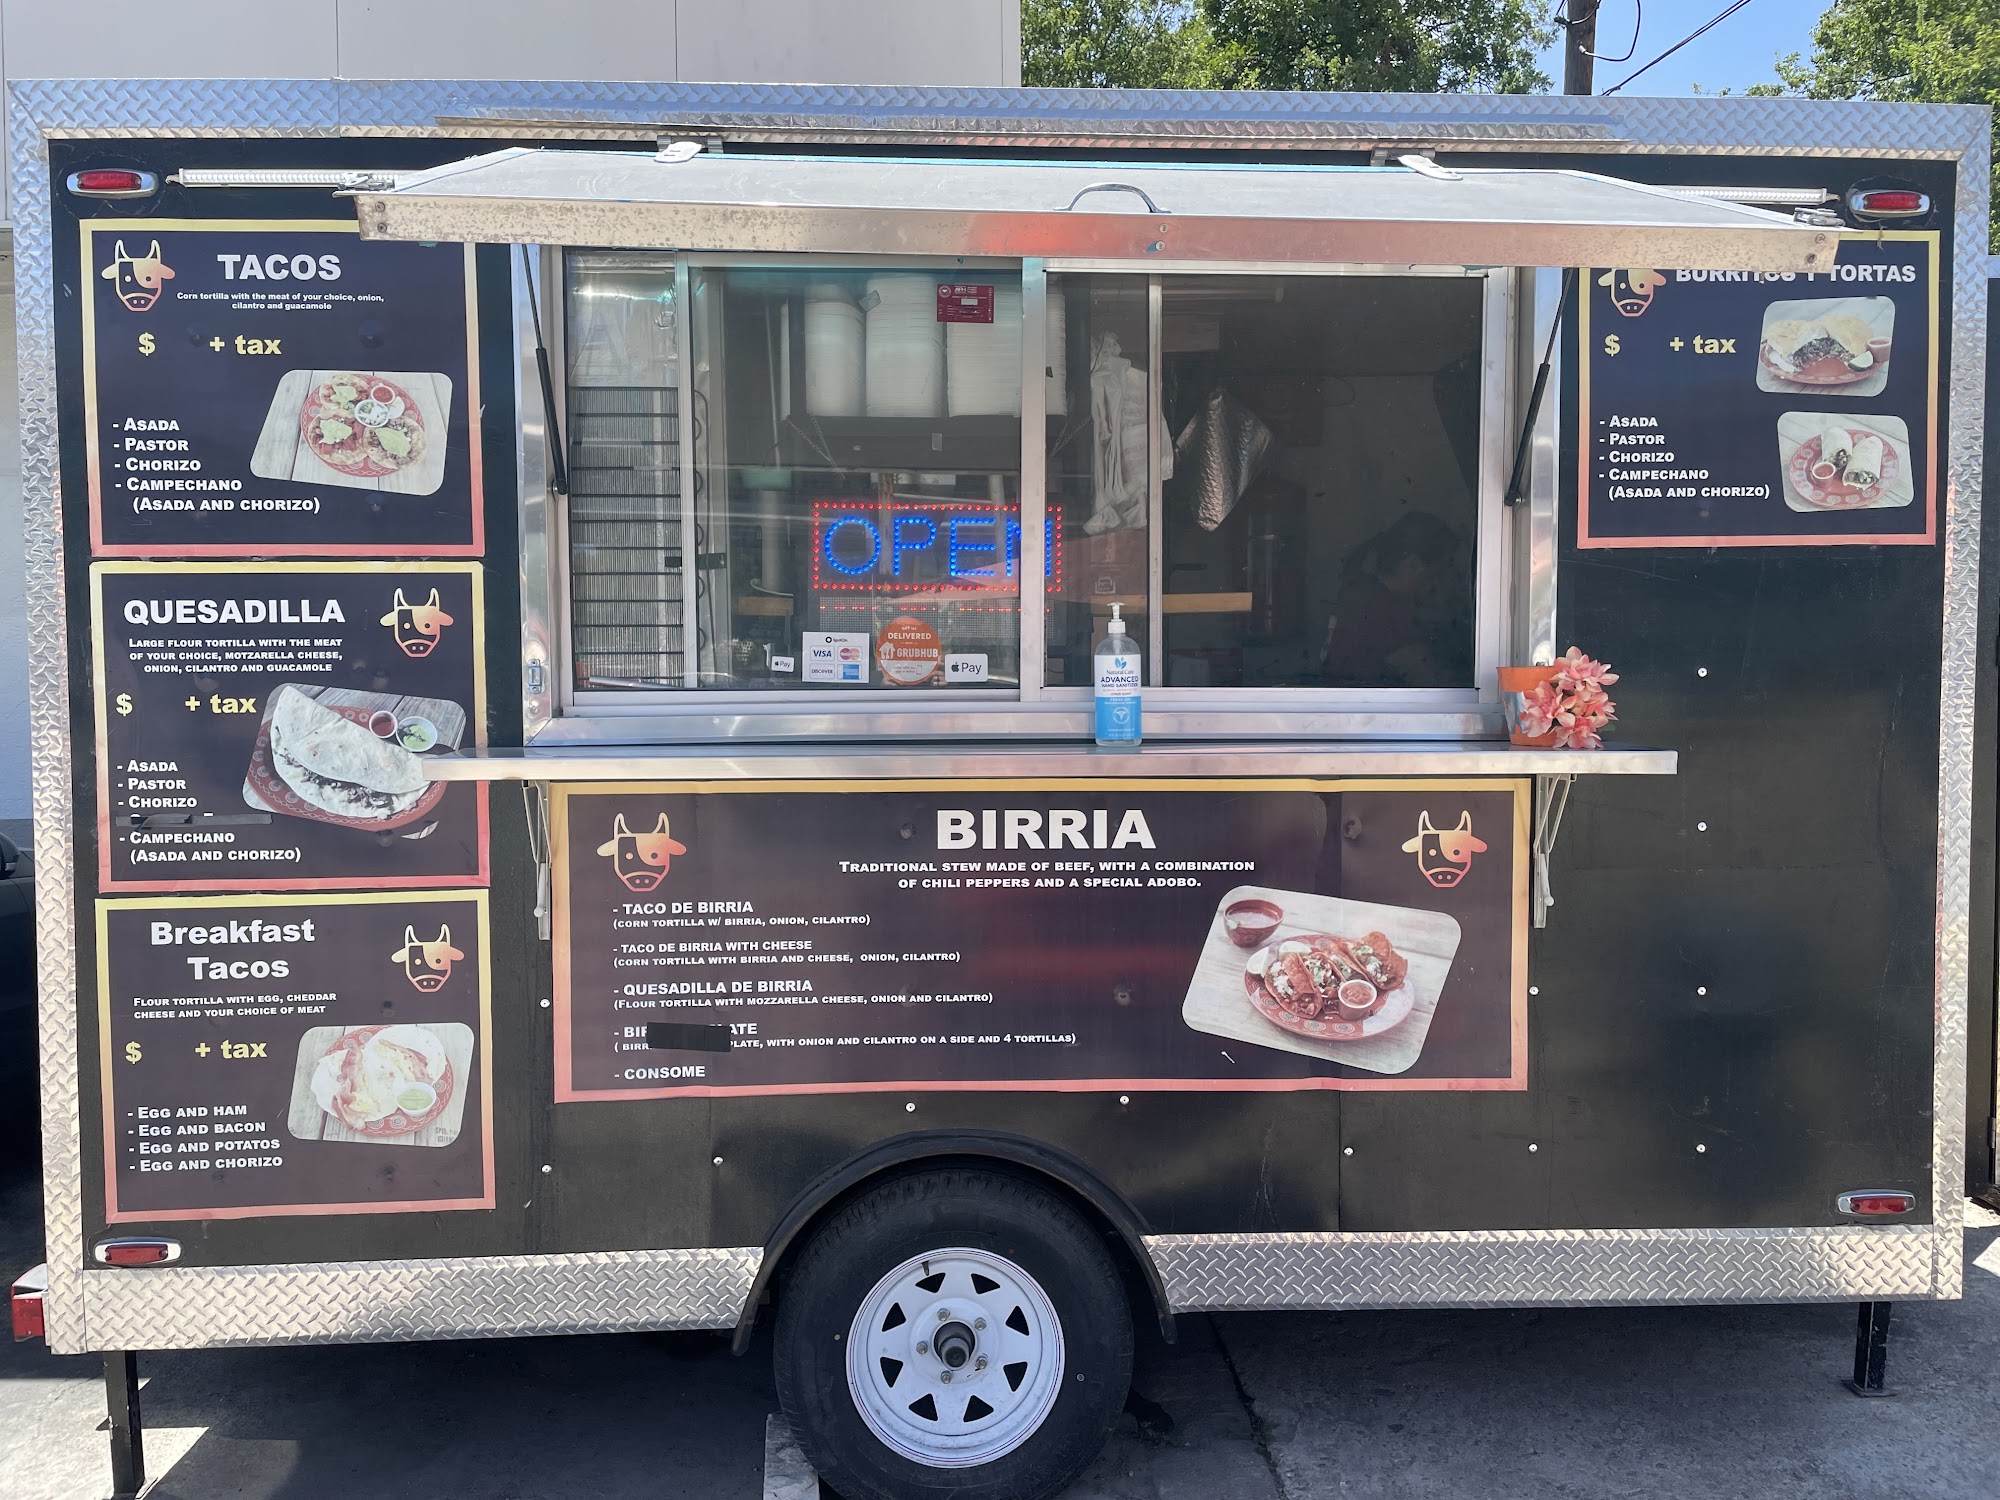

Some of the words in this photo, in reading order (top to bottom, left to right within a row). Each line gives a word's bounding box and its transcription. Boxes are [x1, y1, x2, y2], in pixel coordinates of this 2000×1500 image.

[217, 254, 341, 280] TACOS
[1828, 263, 1916, 282] TORTAS
[177, 292, 198, 300] Corn
[200, 292, 229, 300] tortilla
[231, 292, 250, 300] with
[252, 292, 266, 300] the
[292, 292, 301, 300] of
[302, 294, 322, 302] your
[324, 293, 356, 302] choice,
[357, 294, 384, 302] onion,
[285, 302, 332, 310] guacamole
[234, 334, 282, 354] tax
[1693, 334, 1736, 354] tax
[124, 418, 180, 431] ASADA
[1609, 415, 1658, 427] ASADA
[125, 438, 189, 451] PASTOR
[1610, 433, 1665, 445] PASTOR
[1609, 450, 1674, 463] CHORIZO
[126, 457, 201, 471] CHORIZO
[1609, 468, 1709, 480] CAMPECHANO
[127, 477, 242, 491] CAMPECHANO
[1609, 486, 1662, 501] (ASADA
[1666, 488, 1696, 497] AND
[1701, 484, 1770, 499] CHORIZO)
[133, 497, 195, 514] (ASADA
[200, 500, 234, 510] AND
[240, 497, 320, 514] CHORIZO)
[824, 515, 1052, 578] OPEN
[124, 599, 346, 626] QUESADILLA
[888, 632, 932, 640] DELIVERED
[129, 638, 164, 648] LARGE
[205, 639, 256, 647] TORTILLA
[130, 652, 144, 660] OF
[146, 652, 176, 660] YOUR
[179, 652, 222, 662] CHOICE,
[225, 652, 294, 660] MOTZARELLA
[297, 651, 342, 660] CHEESE,
[813, 649, 832, 658] VISA
[896, 648, 939, 658] GRUBHUB
[144, 665, 182, 674] ONION,
[185, 664, 238, 672] CILANTRO
[241, 664, 263, 672] AND
[266, 664, 332, 672] GUACAMOLE
[961, 662, 982, 674] Pay
[210, 694, 257, 713] tax
[127, 760, 178, 772] ASADA
[128, 778, 186, 790] PASTOR
[128, 796, 197, 808] CHORIZO
[937, 810, 1156, 850] BIRRIA
[130, 832, 235, 844] CAMPECHANO
[130, 849, 187, 865] (ASADA
[191, 851, 223, 861] AND
[228, 847, 301, 862] CHORIZO)
[839, 861, 937, 872] TRADITIONAL
[942, 862, 982, 872] STEW
[986, 862, 1026, 871] MADE
[1031, 862, 1050, 871] OF
[1055, 862, 1094, 873] BEEF,
[1099, 862, 1136, 870] WITH
[1140, 862, 1150, 870] A
[1155, 862, 1254, 870] COMBINATION
[898, 879, 917, 888] OF
[922, 879, 960, 888] CHILI
[966, 878, 1030, 888] PEPPERS
[1034, 878, 1064, 887] AND
[1069, 878, 1079, 887] A
[1083, 878, 1143, 887] SPECIAL
[1147, 878, 1201, 887] ADOBO.
[622, 903, 666, 914] TACO
[672, 902, 693, 914] DE
[698, 901, 754, 913] BIRRIA
[613, 919, 648, 930] (CORN
[652, 919, 705, 927] TORTILLA
[708, 916, 721, 926] W/
[724, 918, 766, 927] BIRRIA,
[769, 917, 808, 926] ONION,
[812, 914, 870, 926] CILANTRO)
[151, 918, 315, 945] Breakfast
[620, 944, 655, 953] TACO
[658, 943, 676, 952] DE
[679, 942, 722, 952] BIRRIA
[726, 942, 758, 951] WITH
[762, 940, 812, 950] CHEESE
[614, 957, 648, 968] (CORN
[652, 957, 705, 966] TORTILLA
[708, 956, 736, 964] WITH
[740, 956, 778, 964] BIRRIA
[780, 955, 804, 963] AND
[808, 954, 853, 963] CHEESE,
[860, 954, 899, 963] ONION,
[902, 951, 960, 962] CILANTRO)
[187, 957, 289, 980] Tacos
[624, 982, 727, 996] QUESADILLA
[732, 981, 752, 992] DE
[758, 980, 813, 992] BIRRIA
[134, 998, 170, 1006] FLOUR
[172, 997, 224, 1006] TORTILLA
[226, 996, 254, 1004] WITH
[258, 995, 284, 1004] EGG,
[286, 993, 336, 1002] CHEDDAR
[614, 999, 656, 1011] (FLOUR
[659, 999, 712, 1007] TORTILLA
[714, 998, 743, 1006] WITH
[747, 996, 818, 1005] MOZZARELLA
[822, 996, 868, 1004] CHEESE,
[935, 992, 993, 1004] CILANTRO)
[134, 1011, 175, 1019] CHEESE
[178, 1010, 201, 1018] AND
[204, 1009, 234, 1017] YOUR
[237, 1007, 277, 1016] CHOICE
[298, 1006, 326, 1014] MEAT
[766, 1039, 794, 1047] WITH
[798, 1038, 834, 1046] ONION
[837, 1037, 860, 1045] AND
[863, 1036, 917, 1044] CILANTRO
[920, 1036, 936, 1044] ON
[1004, 1034, 1012, 1043] 4
[1014, 1033, 1076, 1044] TORTILLAS)
[624, 1066, 705, 1080] CONSOME
[138, 1106, 171, 1119] EGG
[176, 1107, 208, 1118] AND
[214, 1105, 247, 1116] HAM
[138, 1124, 172, 1136] EGG
[176, 1124, 208, 1135] AND
[214, 1122, 265, 1134] BACON
[140, 1142, 172, 1154] EGG
[177, 1142, 209, 1153] AND
[215, 1139, 280, 1151] POTATOS
[140, 1160, 173, 1172] EGG
[178, 1160, 210, 1170] AND
[215, 1156, 282, 1168] CHORIZO
